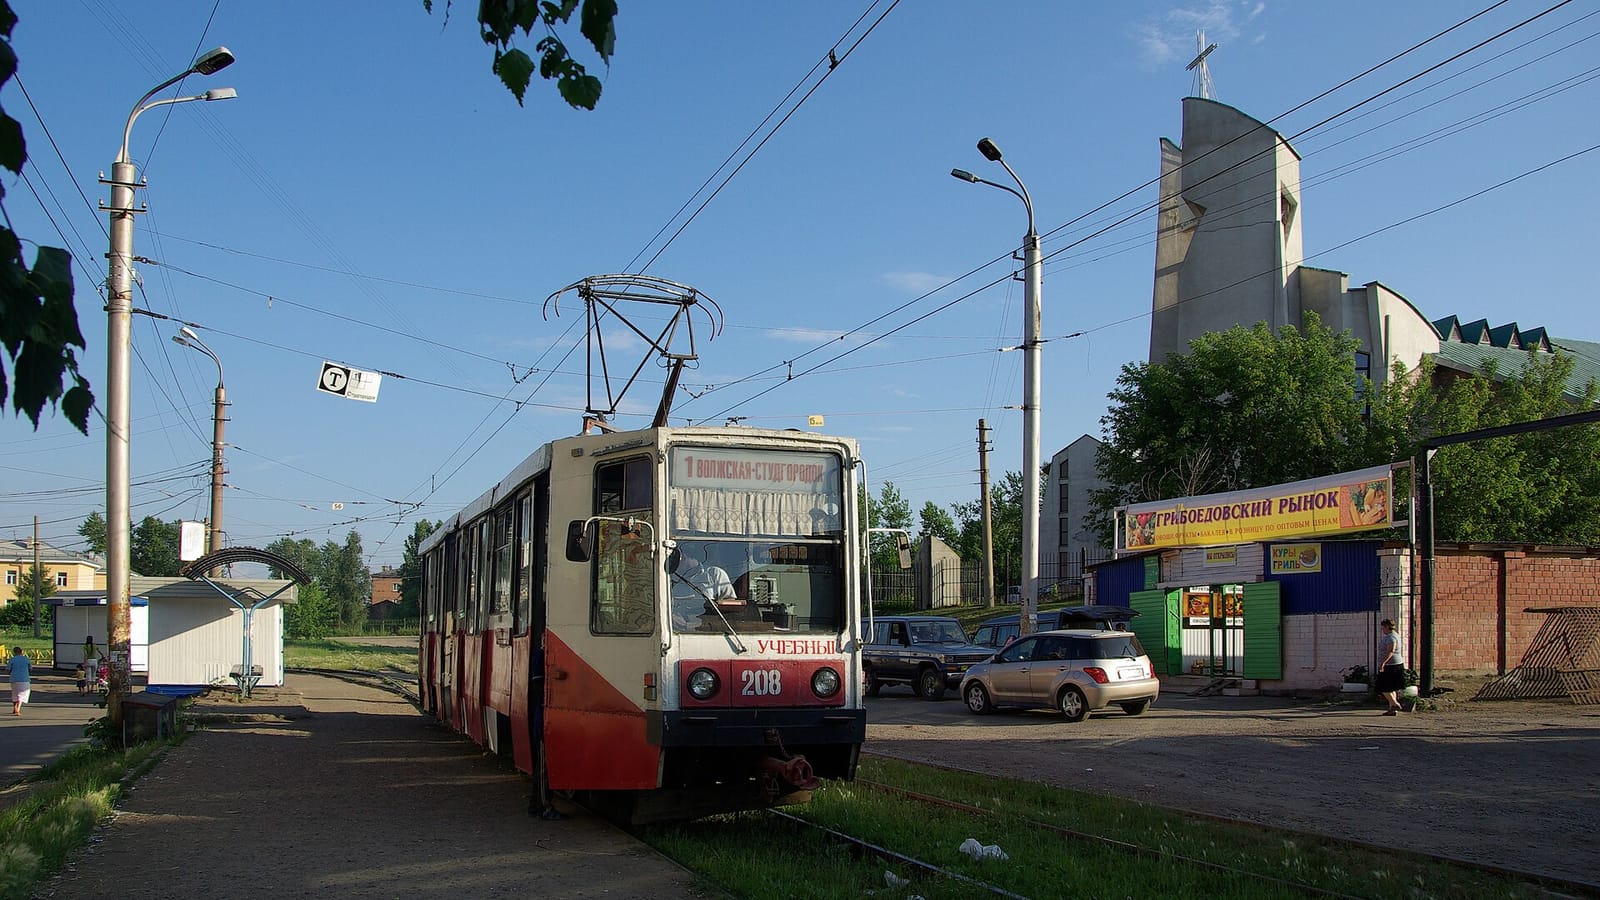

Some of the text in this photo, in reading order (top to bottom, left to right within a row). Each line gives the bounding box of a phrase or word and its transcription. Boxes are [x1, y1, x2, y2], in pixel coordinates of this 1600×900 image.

[685, 456, 693, 478] 1
[1156, 491, 1340, 528] ГРИБОЕДОВСКИЙ РЫНОК
[1265, 524, 1275, 532] ПО
[1276, 520, 1310, 530] ОПТОВЫМ
[1312, 517, 1338, 527] ЦЕНАМ
[1272, 547, 1297, 558] КУРЫ
[1272, 560, 1301, 570] ГРИЛЬ
[741, 669, 782, 696] 208
